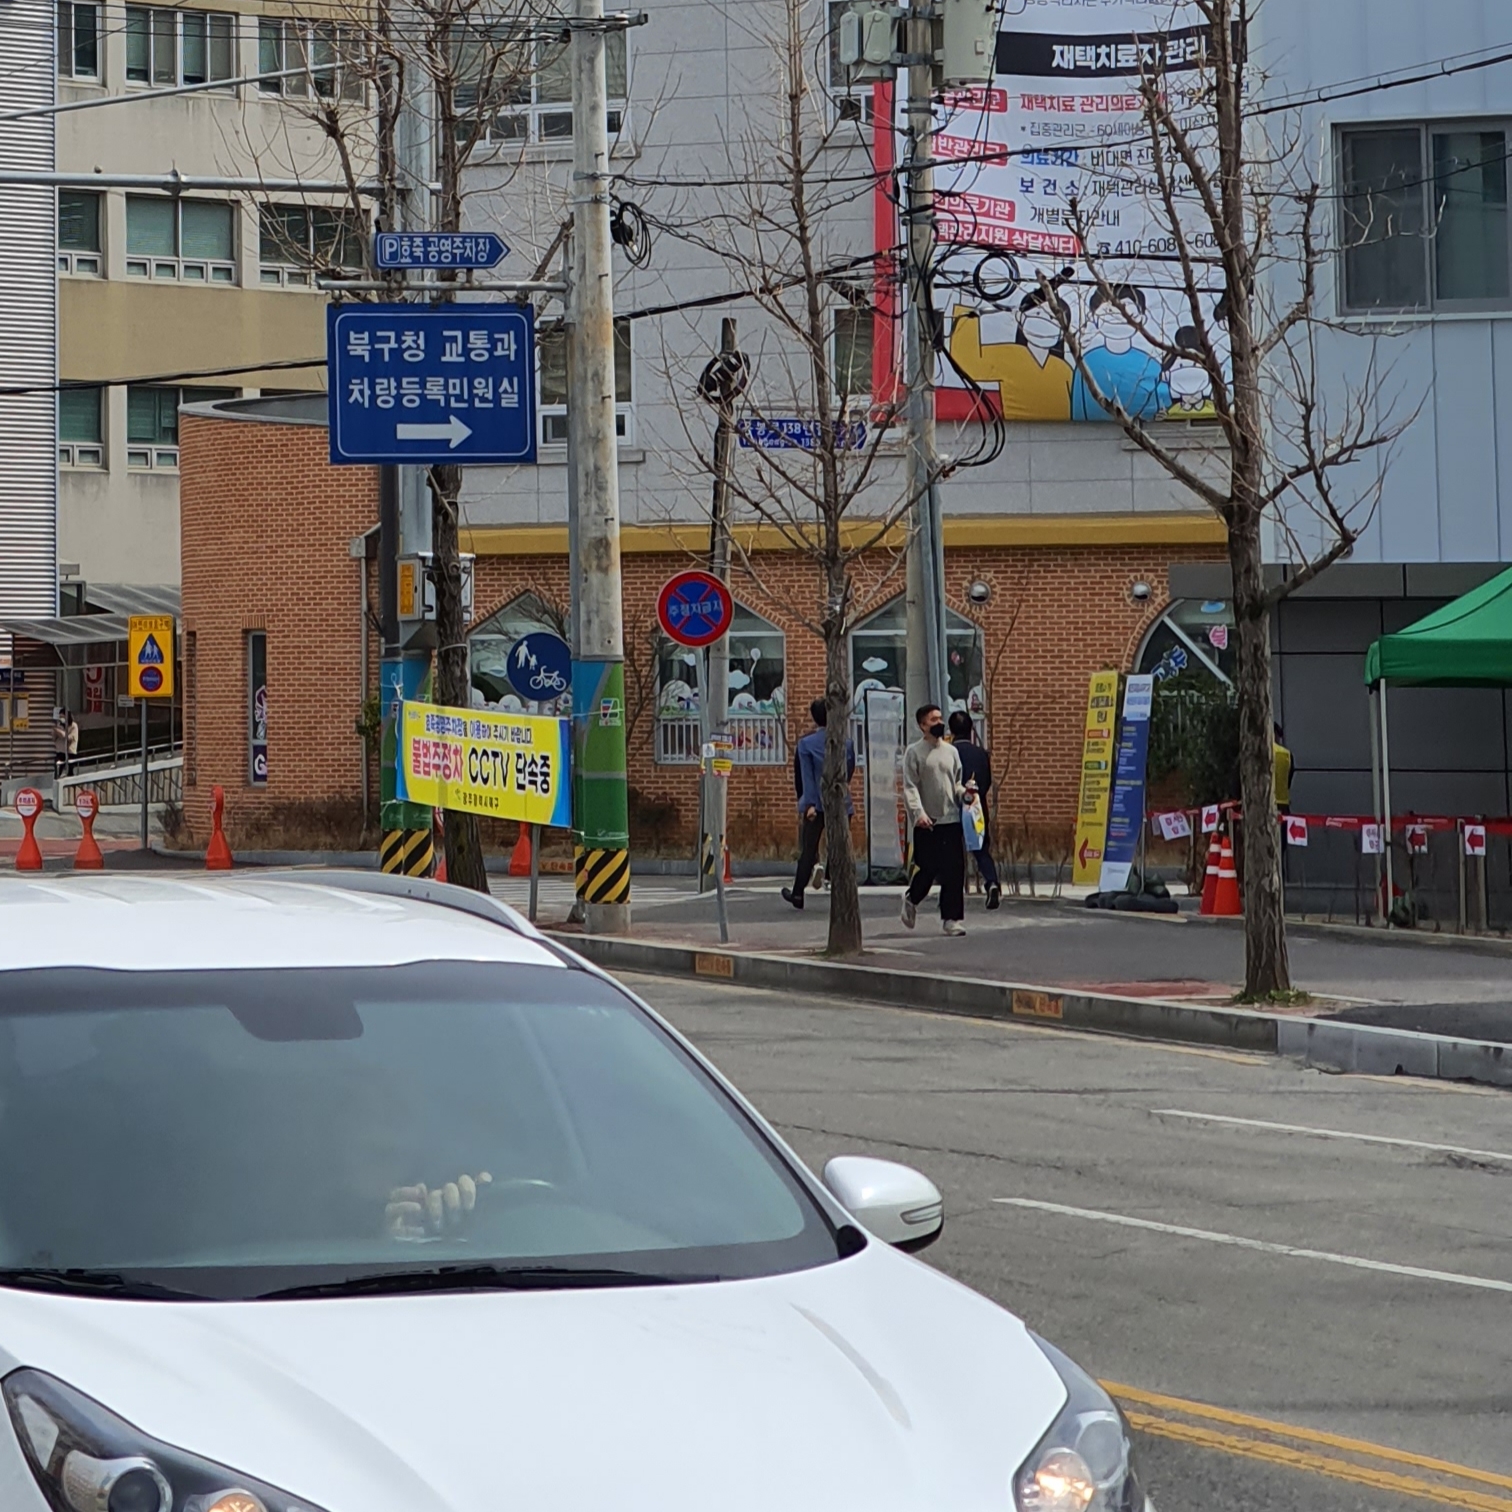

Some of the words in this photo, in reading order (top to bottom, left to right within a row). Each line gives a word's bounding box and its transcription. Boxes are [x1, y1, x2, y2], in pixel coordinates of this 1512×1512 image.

[1051, 42, 1162, 70] 재택치료자
[1165, 34, 1207, 66] 관리
[1020, 94, 1076, 112] 재택치료
[400, 238, 424, 264] 효죽
[427, 238, 491, 264] 공영주차장
[1013, 231, 1077, 254] 상담센터
[347, 330, 426, 363] 북구청
[440, 330, 518, 363] 교통과
[348, 376, 520, 409] 차량등록민원실
[412, 738, 464, 782] 불법주정차
[468, 746, 510, 788] CCTV
[515, 752, 551, 794] 단속중
